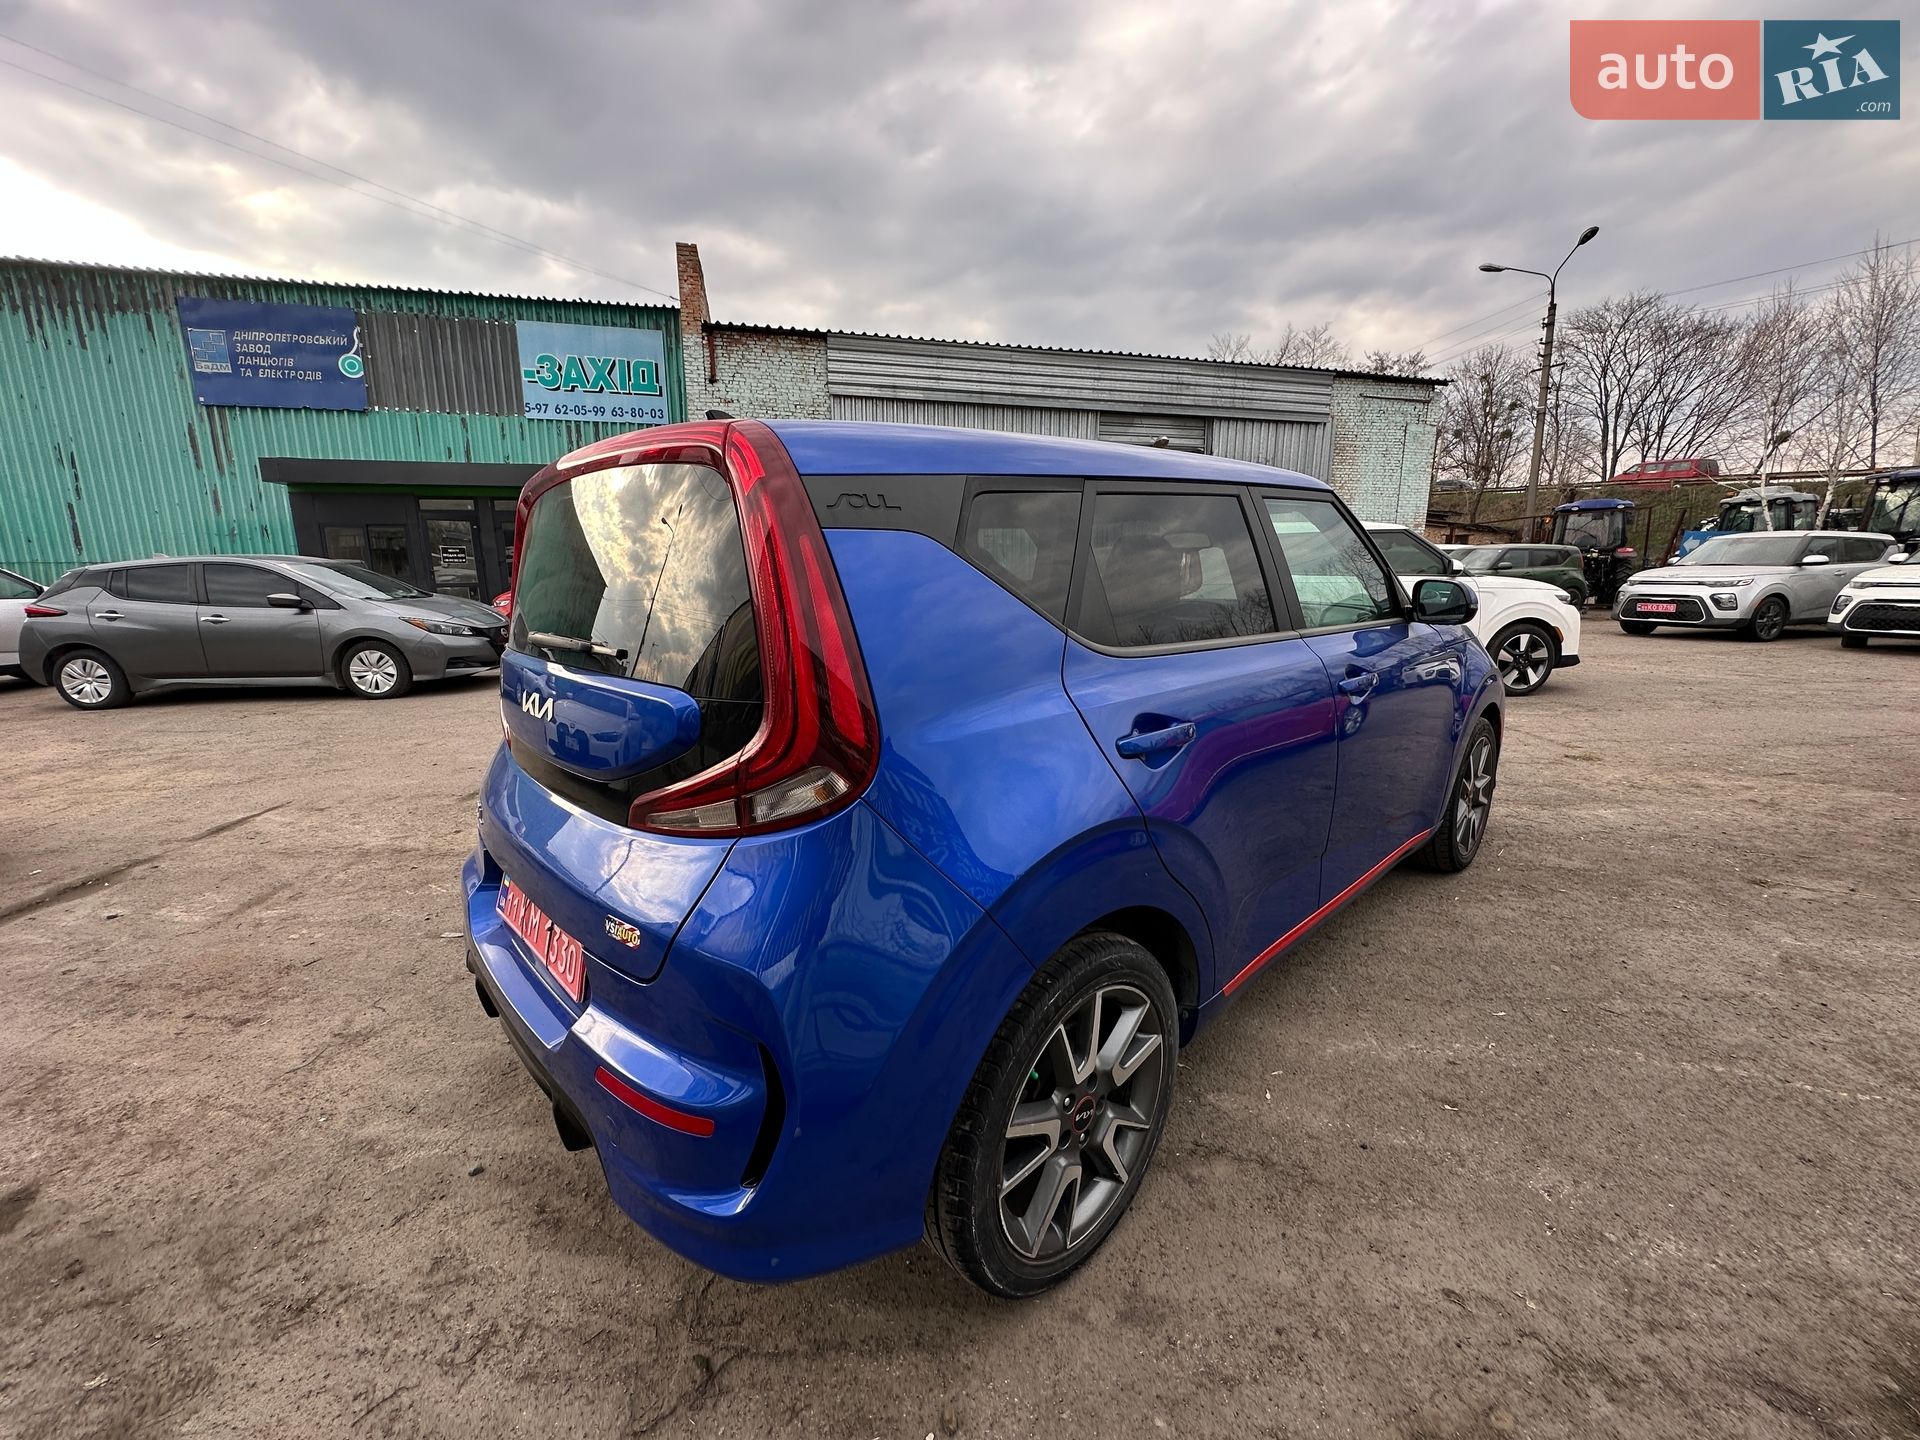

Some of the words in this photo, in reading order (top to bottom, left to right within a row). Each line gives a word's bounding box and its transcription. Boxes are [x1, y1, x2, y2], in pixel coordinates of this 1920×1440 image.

[233, 330, 348, 346] ДНІПРОПЕТРОВСЬКИЙ
[235, 343, 272, 355] ЗАВОД
[237, 355, 294, 367] ЛАНЦЮГІВ
[240, 368, 253, 377] ТА
[258, 369, 322, 381] ЕЛЕКТРОДІВ
[554, 404, 606, 417] 62-05-99
[611, 406, 664, 419] 63-80-03
